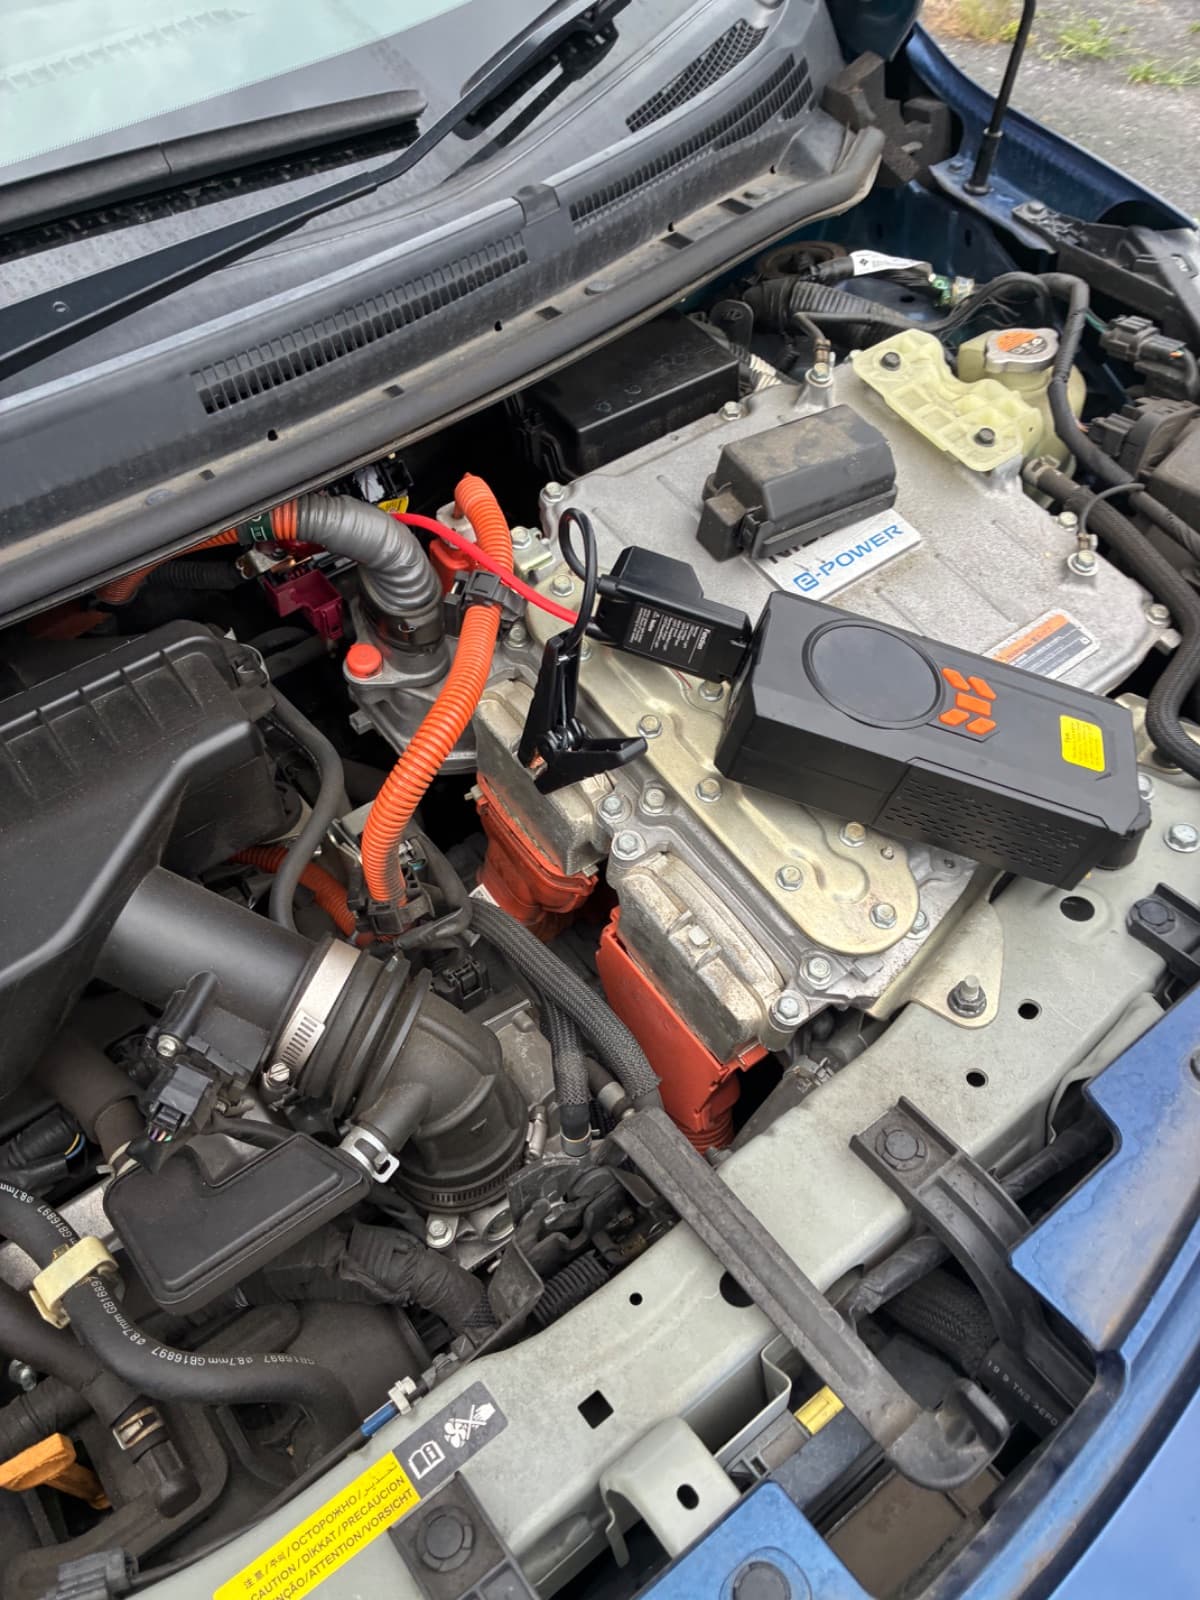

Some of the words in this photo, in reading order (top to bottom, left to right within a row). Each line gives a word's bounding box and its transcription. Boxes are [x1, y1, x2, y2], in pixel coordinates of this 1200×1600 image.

[793, 524, 903, 592] e-POWER
[36, 1204, 73, 1238] GB16897
[151, 1346, 205, 1366] GB16897
